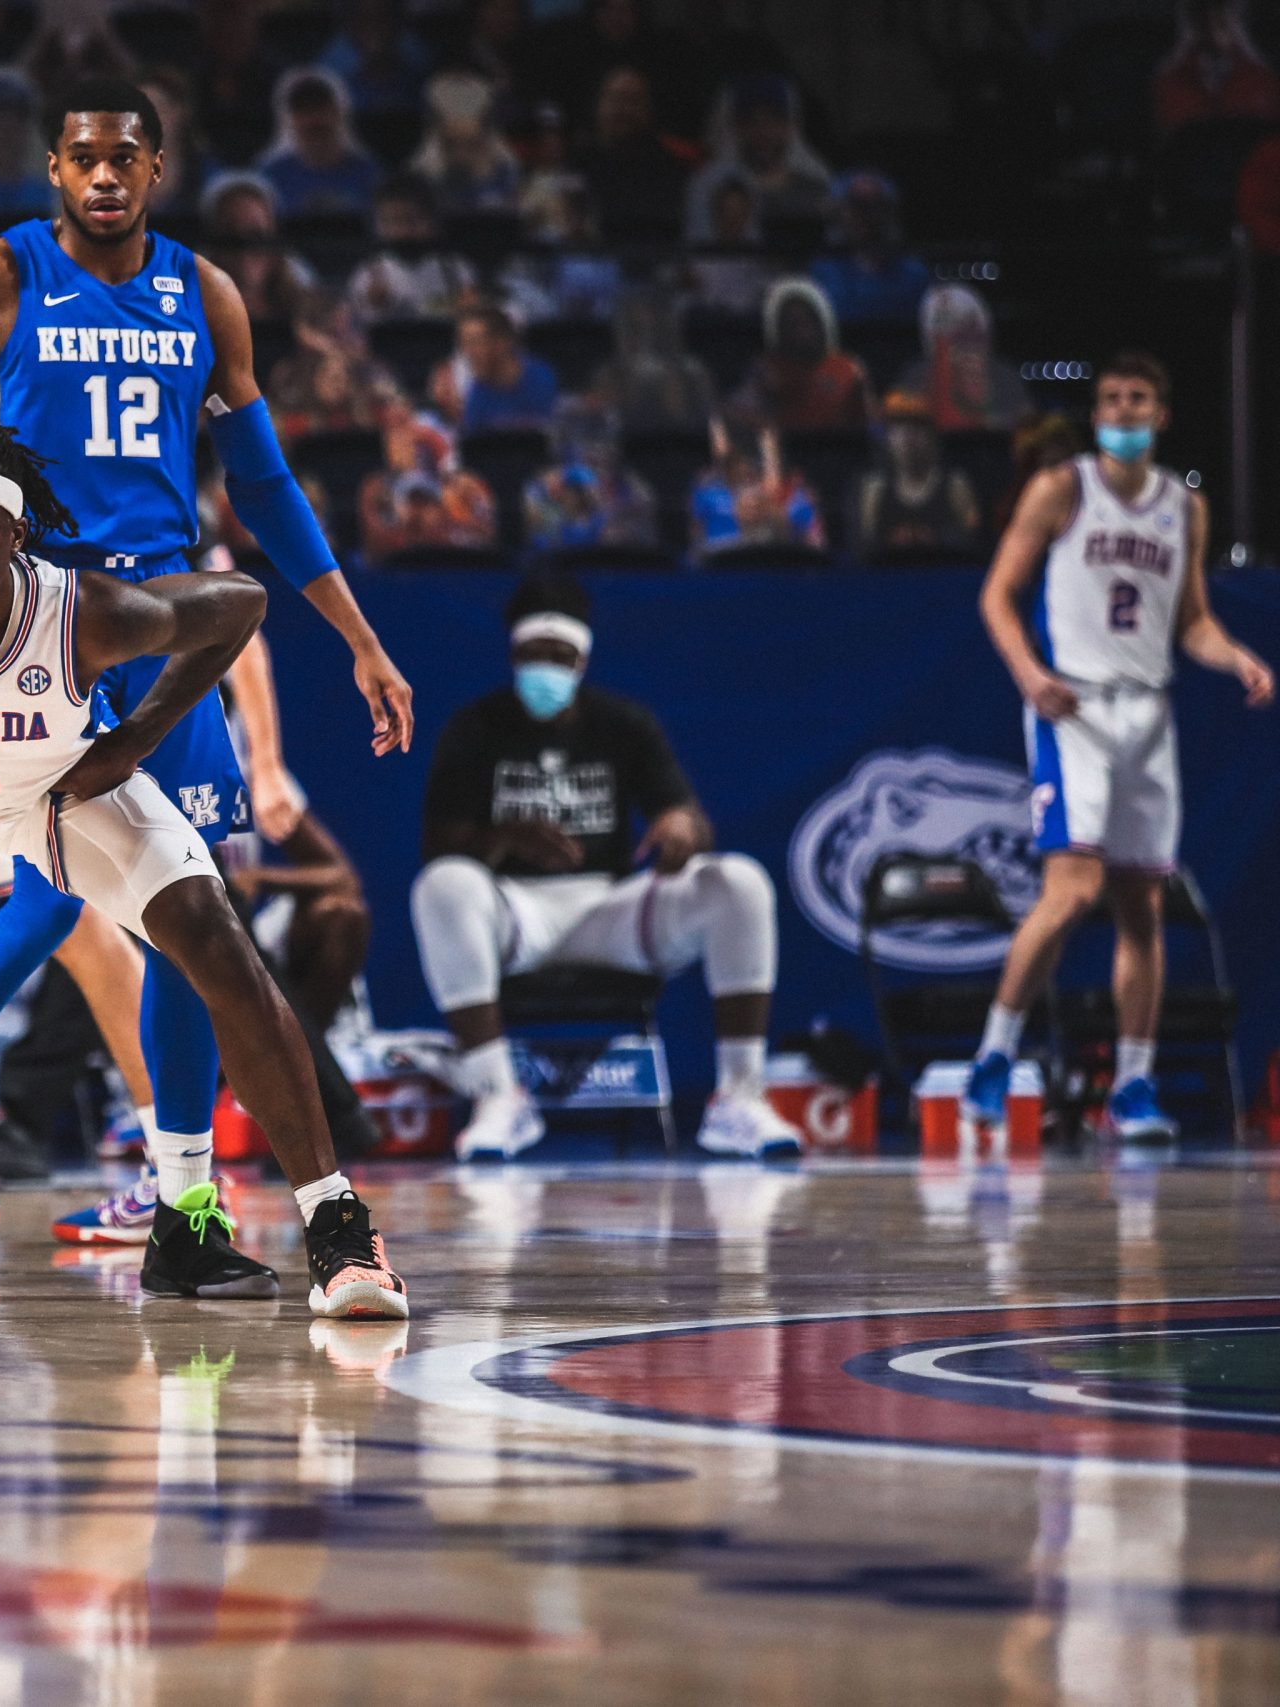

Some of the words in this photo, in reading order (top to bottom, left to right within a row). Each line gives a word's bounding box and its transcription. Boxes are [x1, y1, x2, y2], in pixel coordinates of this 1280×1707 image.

[37, 327, 196, 366] KENTUCKY
[83, 375, 160, 457] 12
[1109, 580, 1140, 633] 2
[21, 671, 49, 693] SEC
[179, 783, 220, 828] UK
